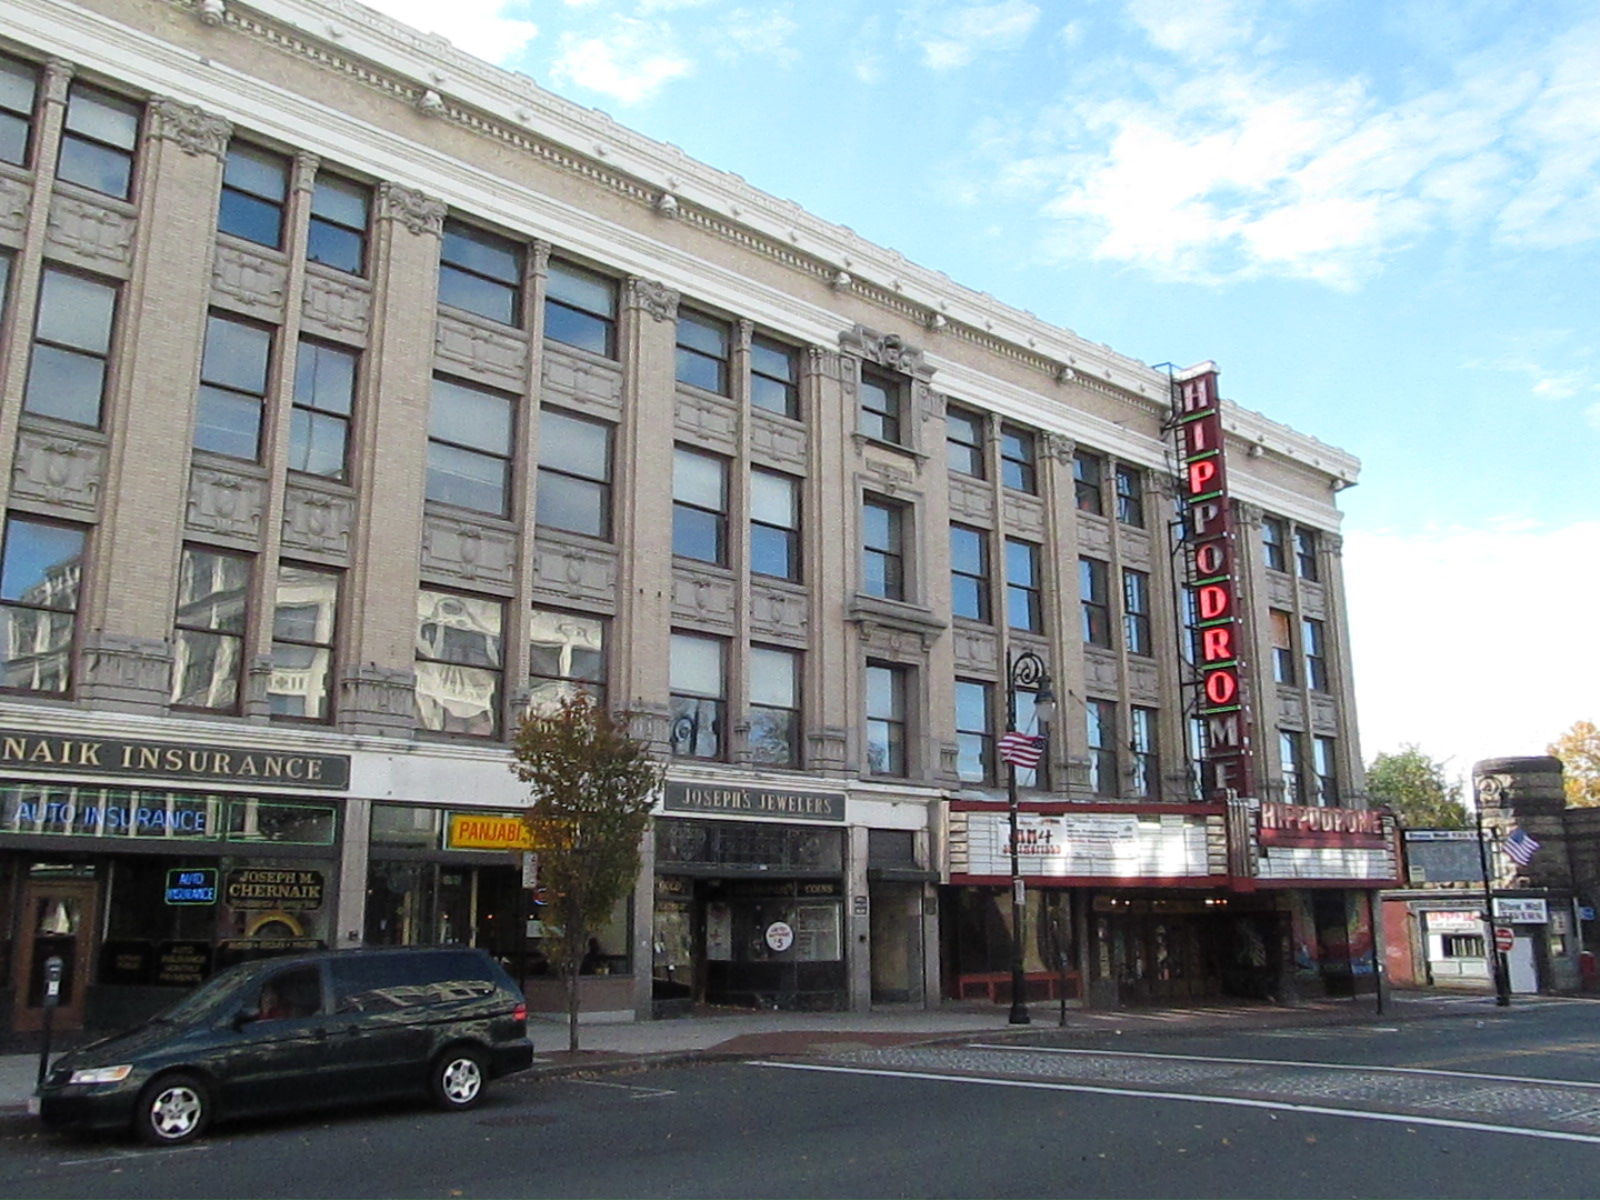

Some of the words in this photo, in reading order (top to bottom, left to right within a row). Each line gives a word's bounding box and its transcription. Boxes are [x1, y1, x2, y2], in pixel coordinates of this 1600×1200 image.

[1182, 378, 1238, 789] HIPPODROME
[2, 736, 101, 766] NAIK
[121, 745, 322, 780] INSURANCE
[682, 787, 751, 808] JOSEPH'S
[758, 793, 832, 813] JEWELERS
[13, 802, 75, 823] AUTO
[84, 806, 206, 830] INSURANCE
[1261, 802, 1383, 834] HIPPODROME
[459, 821, 520, 842] PANJABI
[229, 883, 321, 898] CHERNAIK
[239, 871, 296, 884] JOSEPH
